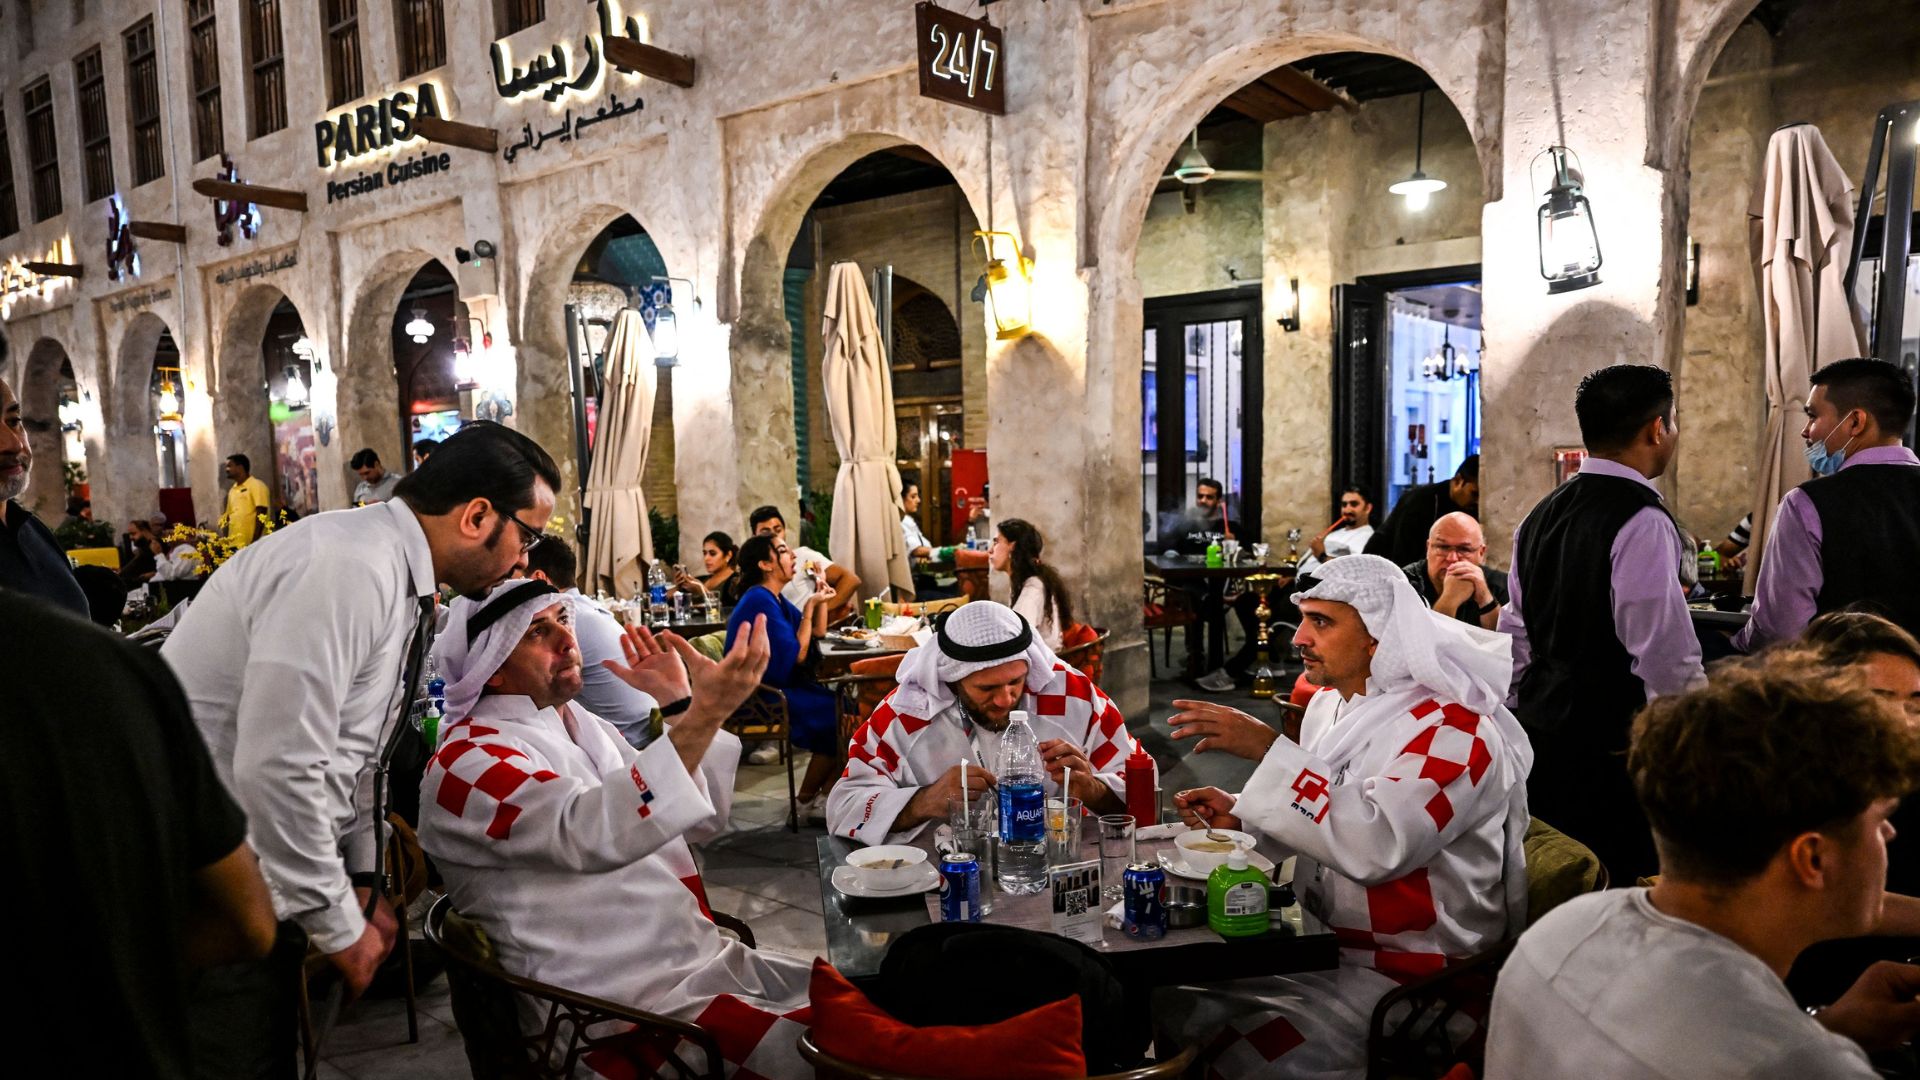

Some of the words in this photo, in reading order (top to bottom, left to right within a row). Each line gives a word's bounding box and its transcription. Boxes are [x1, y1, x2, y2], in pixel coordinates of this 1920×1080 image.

[930, 23, 998, 98] 24/7
[315, 83, 442, 168] PARISA
[575, 93, 644, 139] مطعم
[327, 171, 384, 204] Persian
[387, 151, 451, 186] Cuisine
